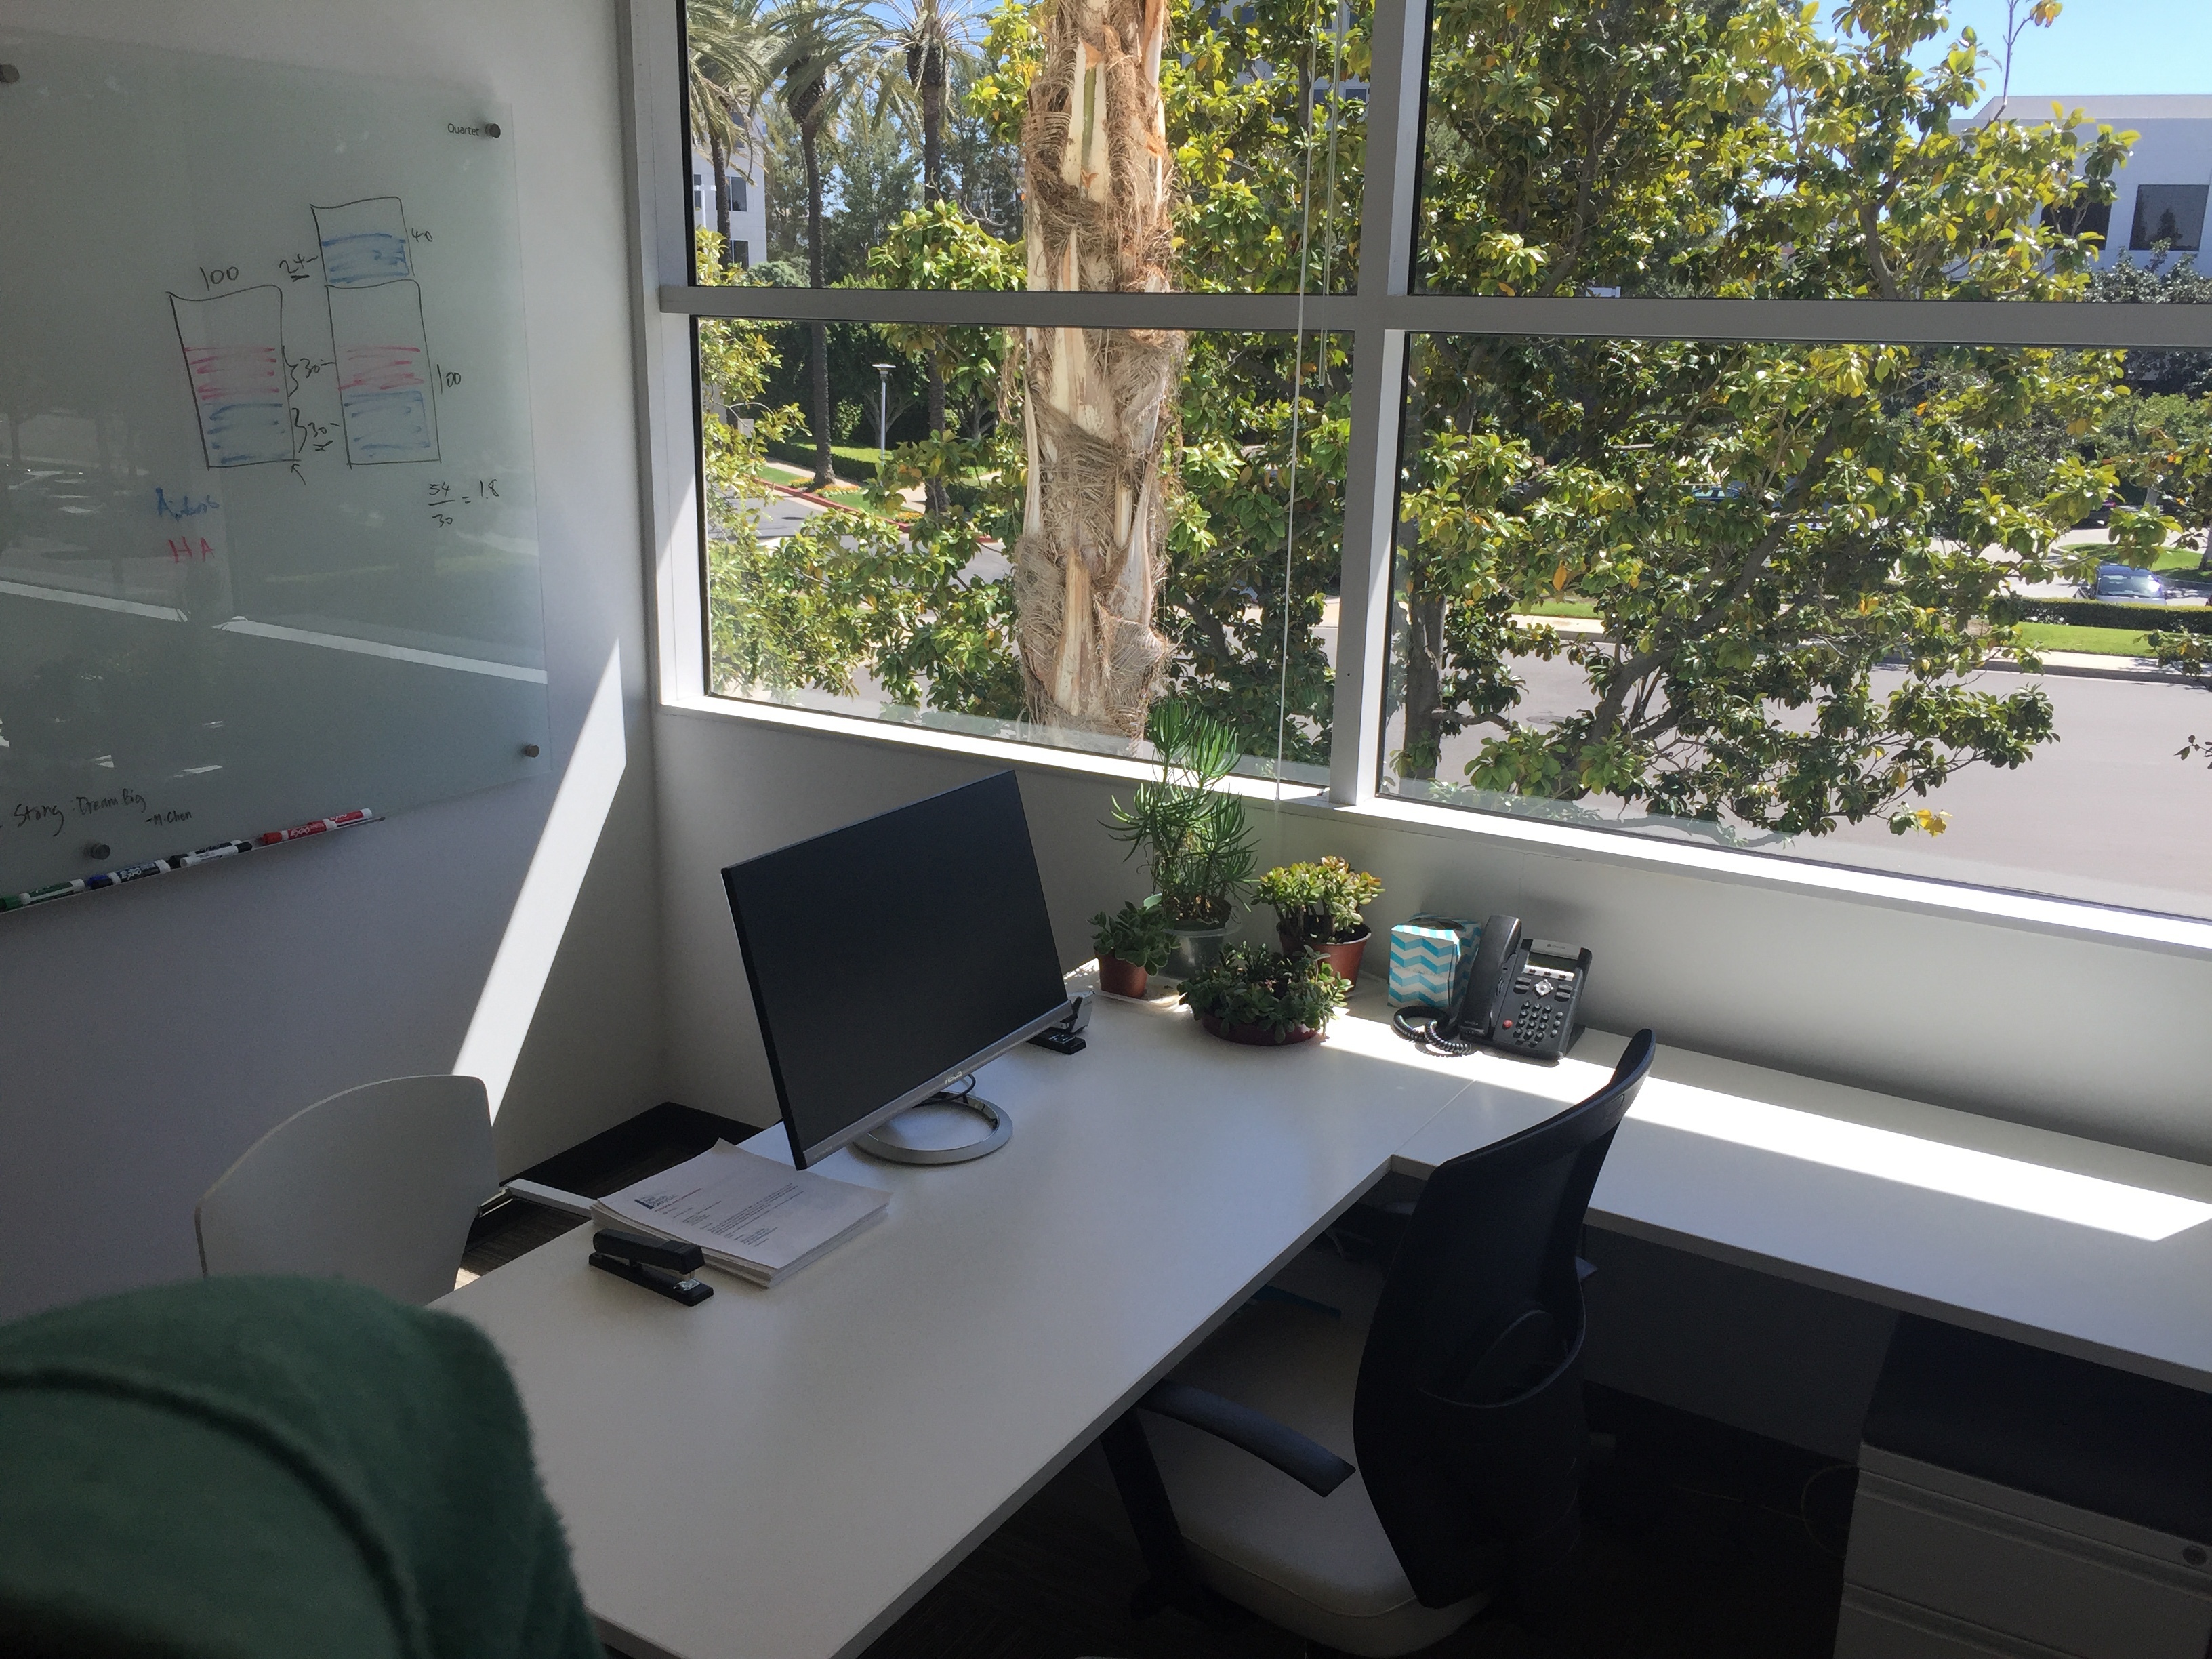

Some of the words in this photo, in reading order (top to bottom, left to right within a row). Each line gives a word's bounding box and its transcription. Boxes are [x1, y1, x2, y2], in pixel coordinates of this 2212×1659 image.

[447, 123, 480, 136] Quartet
[411, 227, 433, 243] 40
[199, 266, 239, 291] 100
[300, 358, 321, 379] 30
[436, 363, 462, 395] 100
[308, 422, 327, 438] 30
[428, 481, 451, 497] 54
[432, 514, 453, 528] 30
[122, 787, 147, 813] Big
[289, 826, 311, 838] EXPO
[119, 867, 142, 881] EXPO
